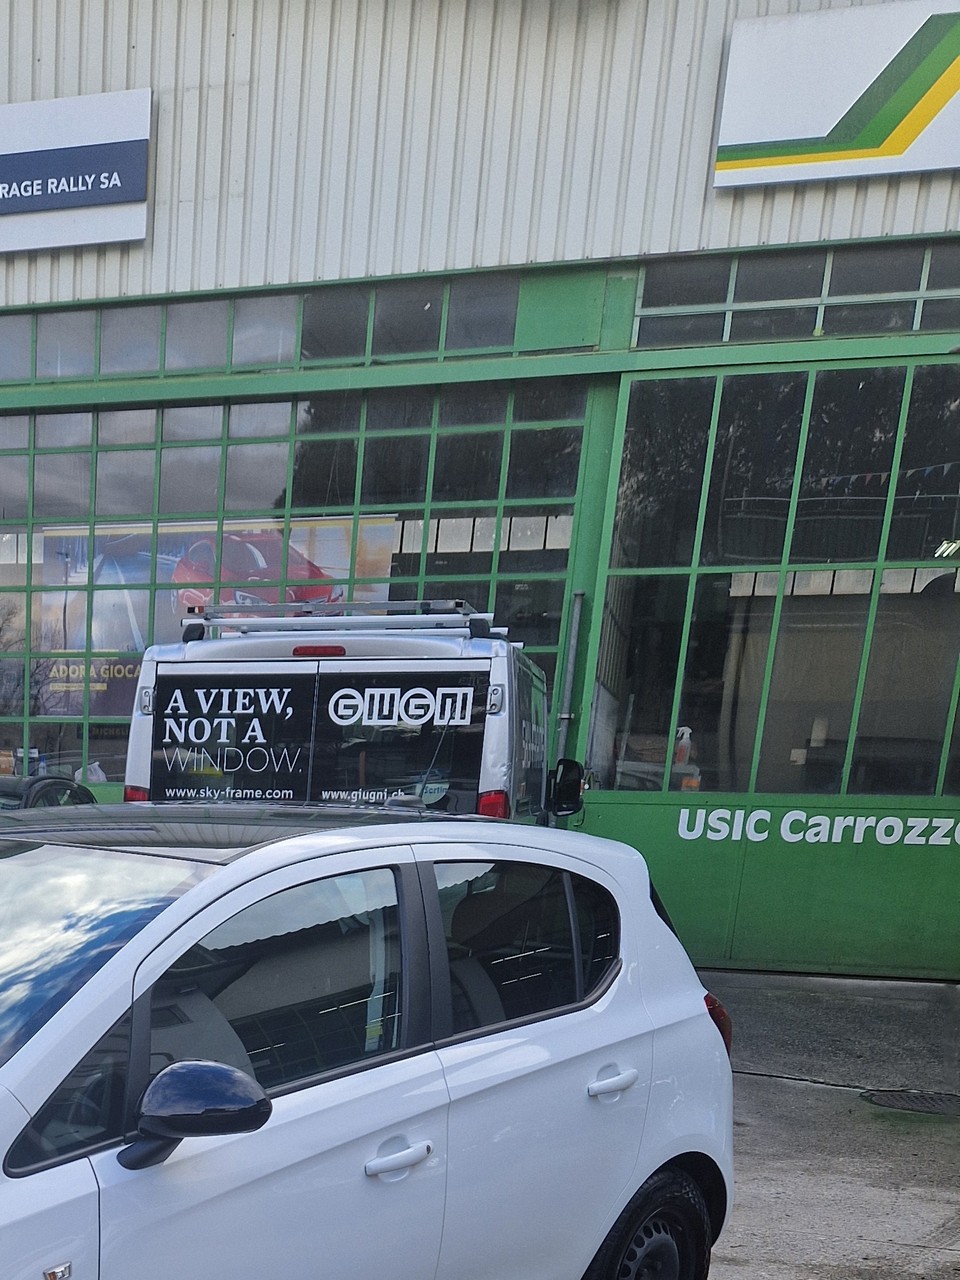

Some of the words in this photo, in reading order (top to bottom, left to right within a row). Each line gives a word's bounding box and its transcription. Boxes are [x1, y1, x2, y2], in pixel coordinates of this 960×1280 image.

[47, 174, 96, 194] RALLY
[99, 172, 122, 189] SA
[164, 688, 189, 714] A
[194, 688, 294, 720] VIEW,
[162, 717, 236, 743] NOT
[241, 717, 267, 743] A
[162, 747, 302, 773] WINDOW.
[165, 786, 294, 800] www.sky-frame.com
[677, 808, 771, 841] USIC
[779, 810, 960, 845] Carrozz
